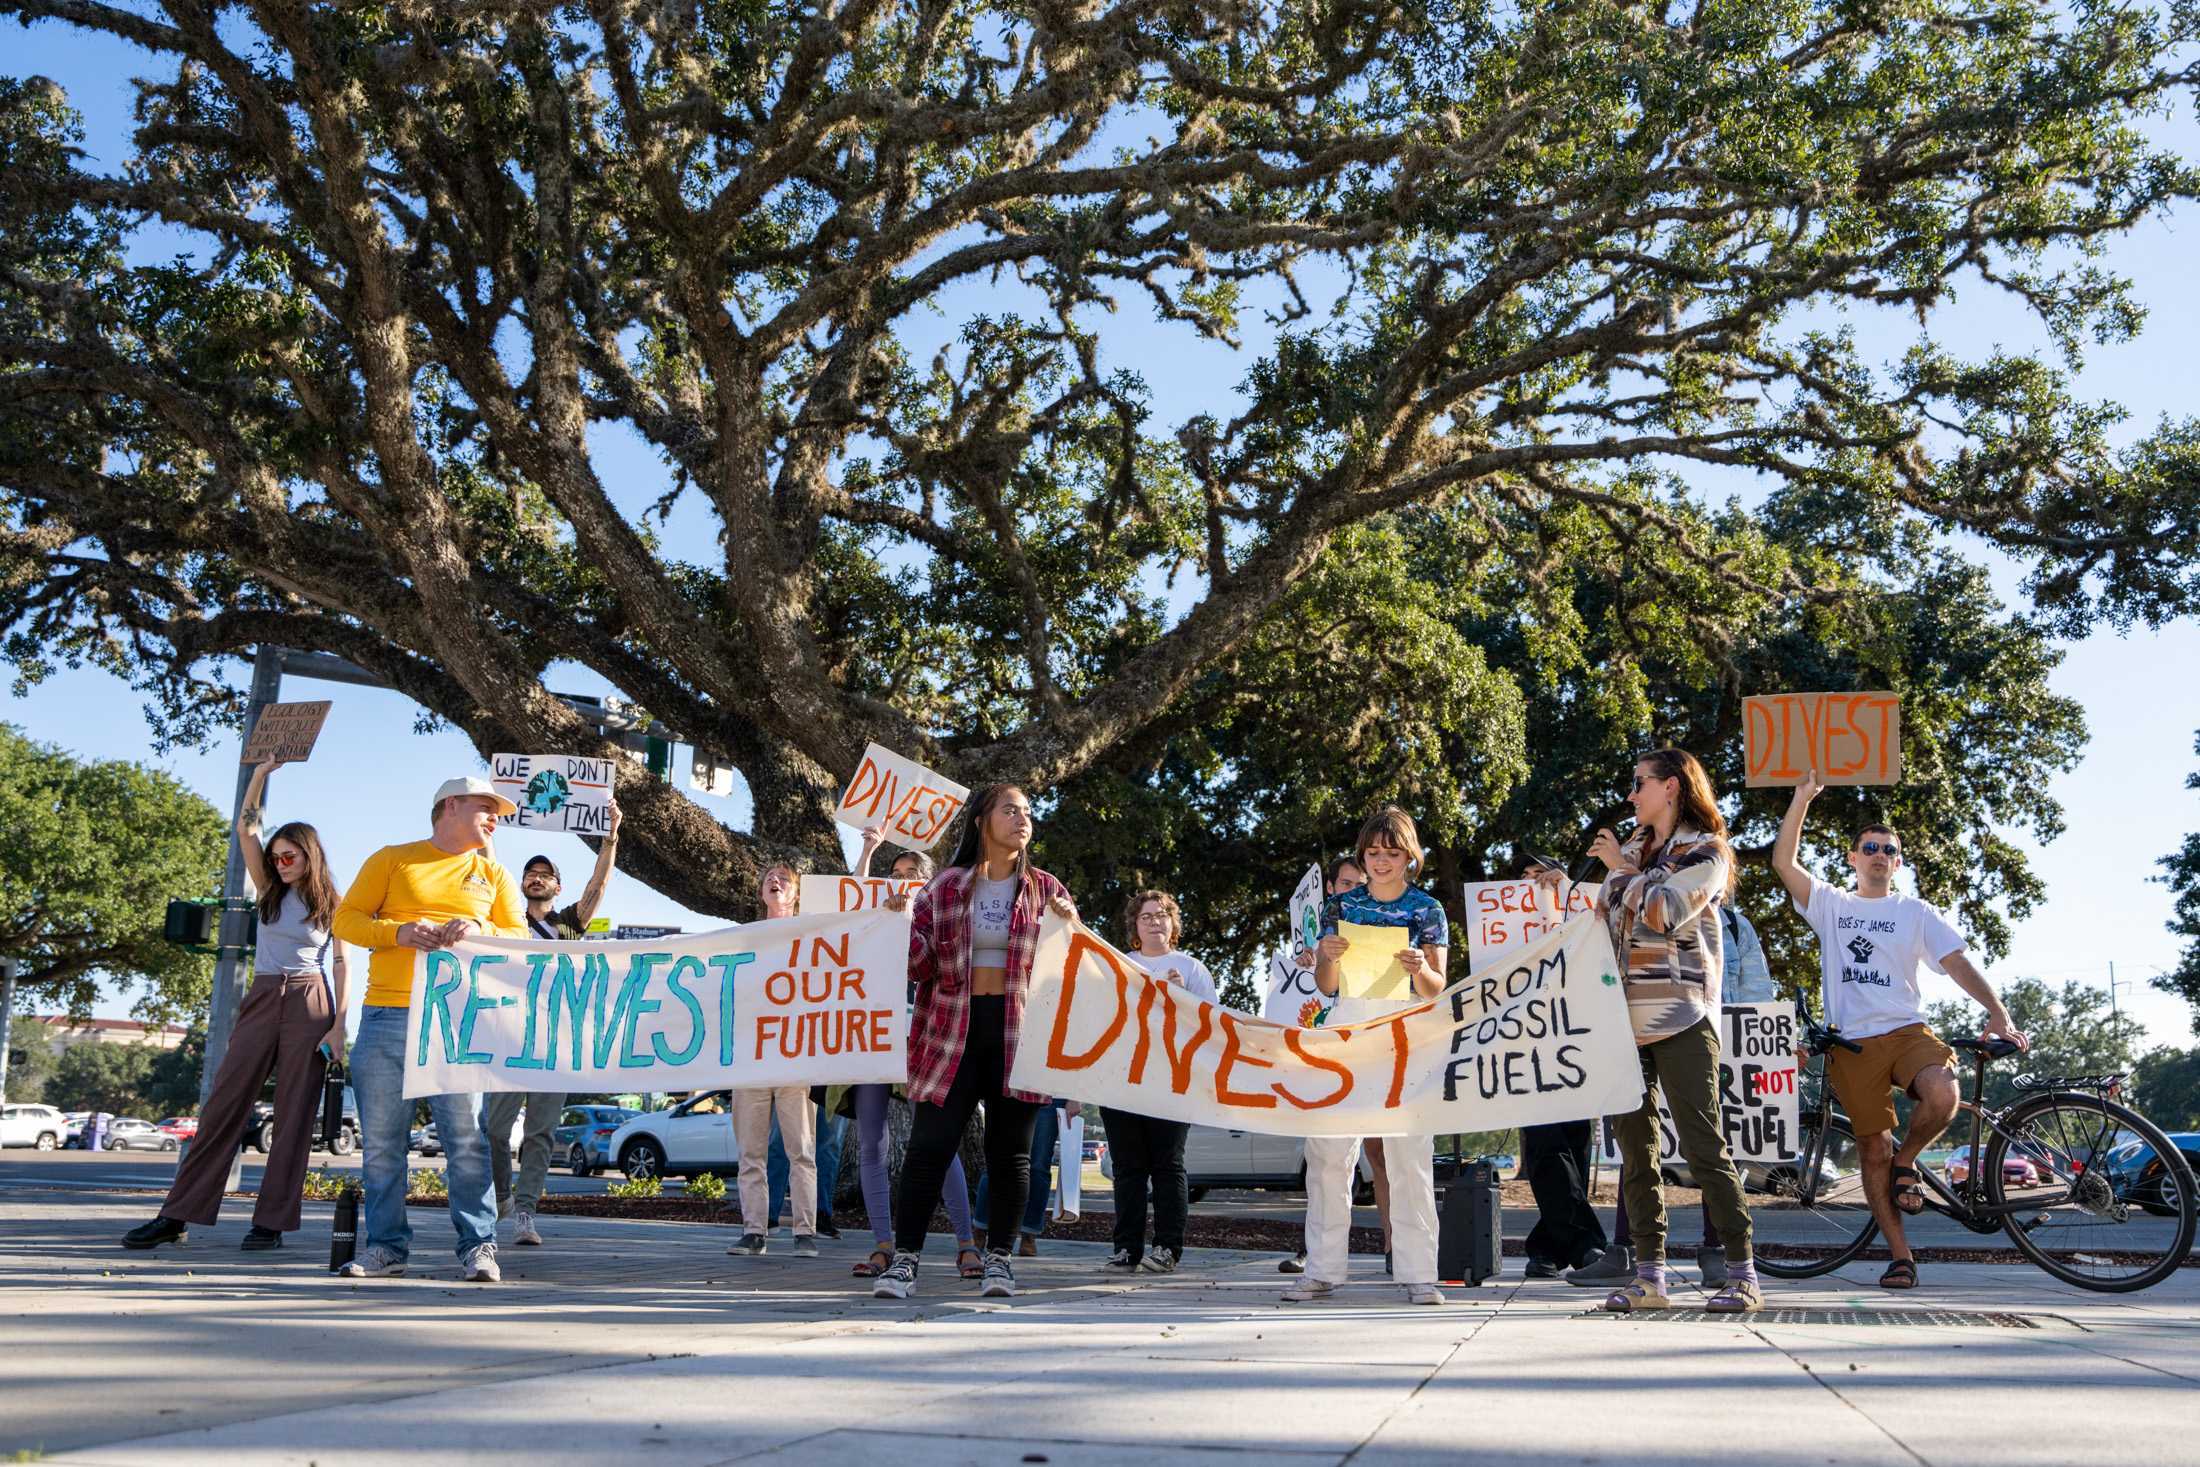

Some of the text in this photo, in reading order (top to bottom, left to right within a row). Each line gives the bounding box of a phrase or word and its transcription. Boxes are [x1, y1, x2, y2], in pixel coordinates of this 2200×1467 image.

[260, 719, 317, 732] WITHOUT
[1746, 694, 1901, 780] DIVEST
[495, 758, 614, 783] WE DON'T
[843, 757, 964, 843] DIVEST
[1477, 884, 1539, 913] sea
[1482, 917, 1508, 946] is
[1868, 920, 1896, 933] JAMES
[788, 933, 850, 968] IN
[765, 969, 866, 1006] OUR
[1279, 961, 1318, 995] YO
[1451, 948, 1567, 1023] FROM
[418, 950, 757, 1071] RE-INVEST
[1046, 932, 1437, 1110] DIVEST
[1450, 997, 1592, 1055] FOSSIL
[1744, 1015, 1792, 1036] FOR
[755, 1009, 894, 1060] FUTURE
[1746, 1036, 1792, 1057] OUR
[1442, 1045, 1587, 1102] FUELS
[1754, 1069, 1796, 1095] NOT
[1721, 1104, 1797, 1160] FUEL
